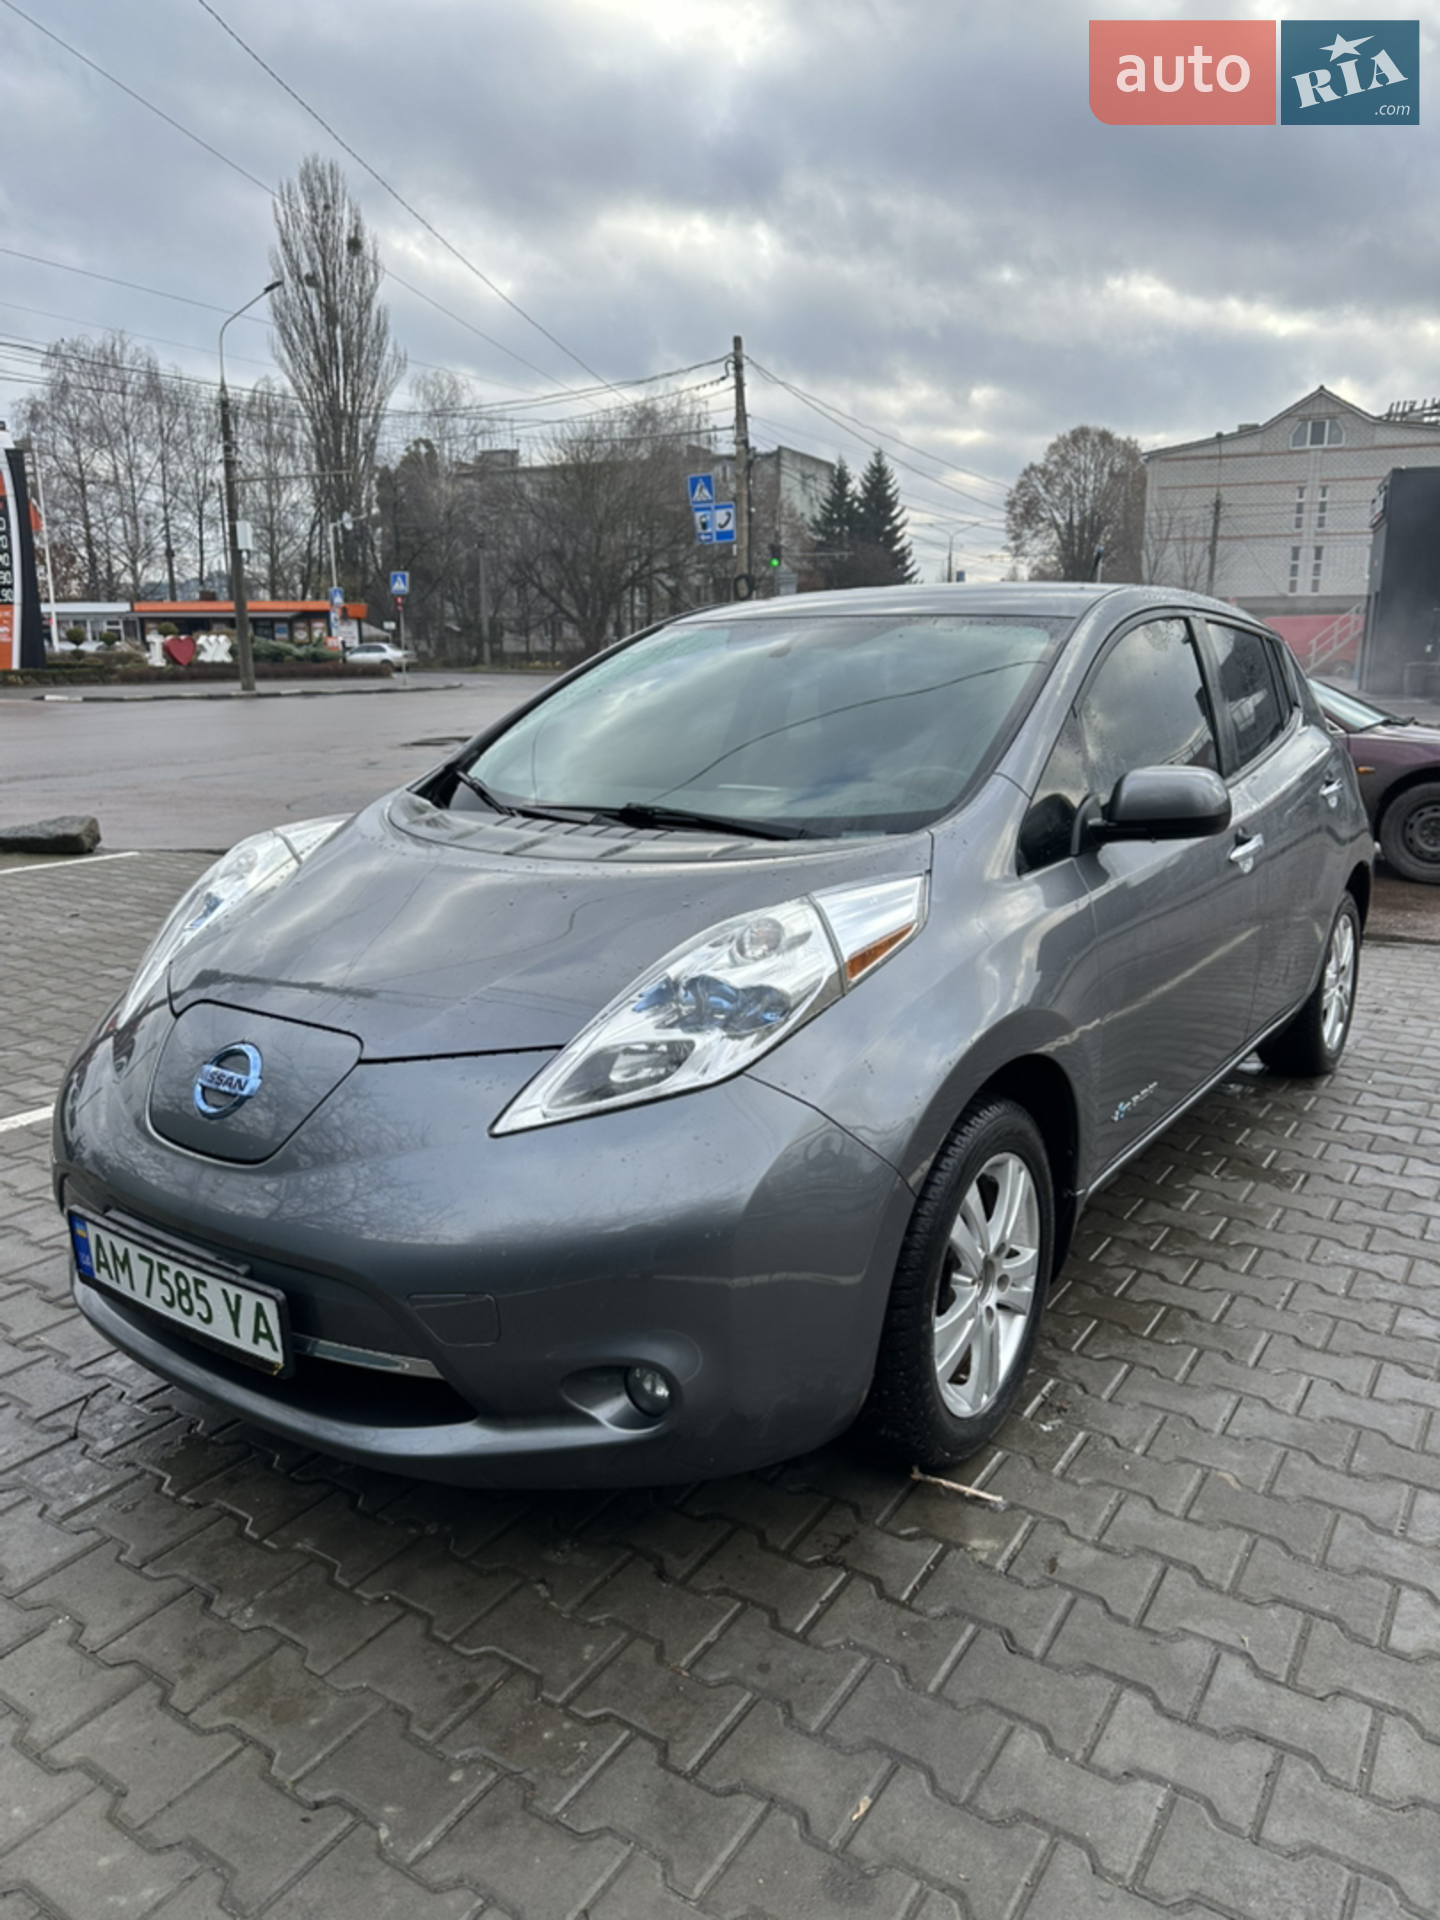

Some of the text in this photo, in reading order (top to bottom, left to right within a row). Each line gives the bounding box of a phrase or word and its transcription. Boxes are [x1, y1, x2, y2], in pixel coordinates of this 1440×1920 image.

[95, 1233, 279, 1353] AM 7585 YA
